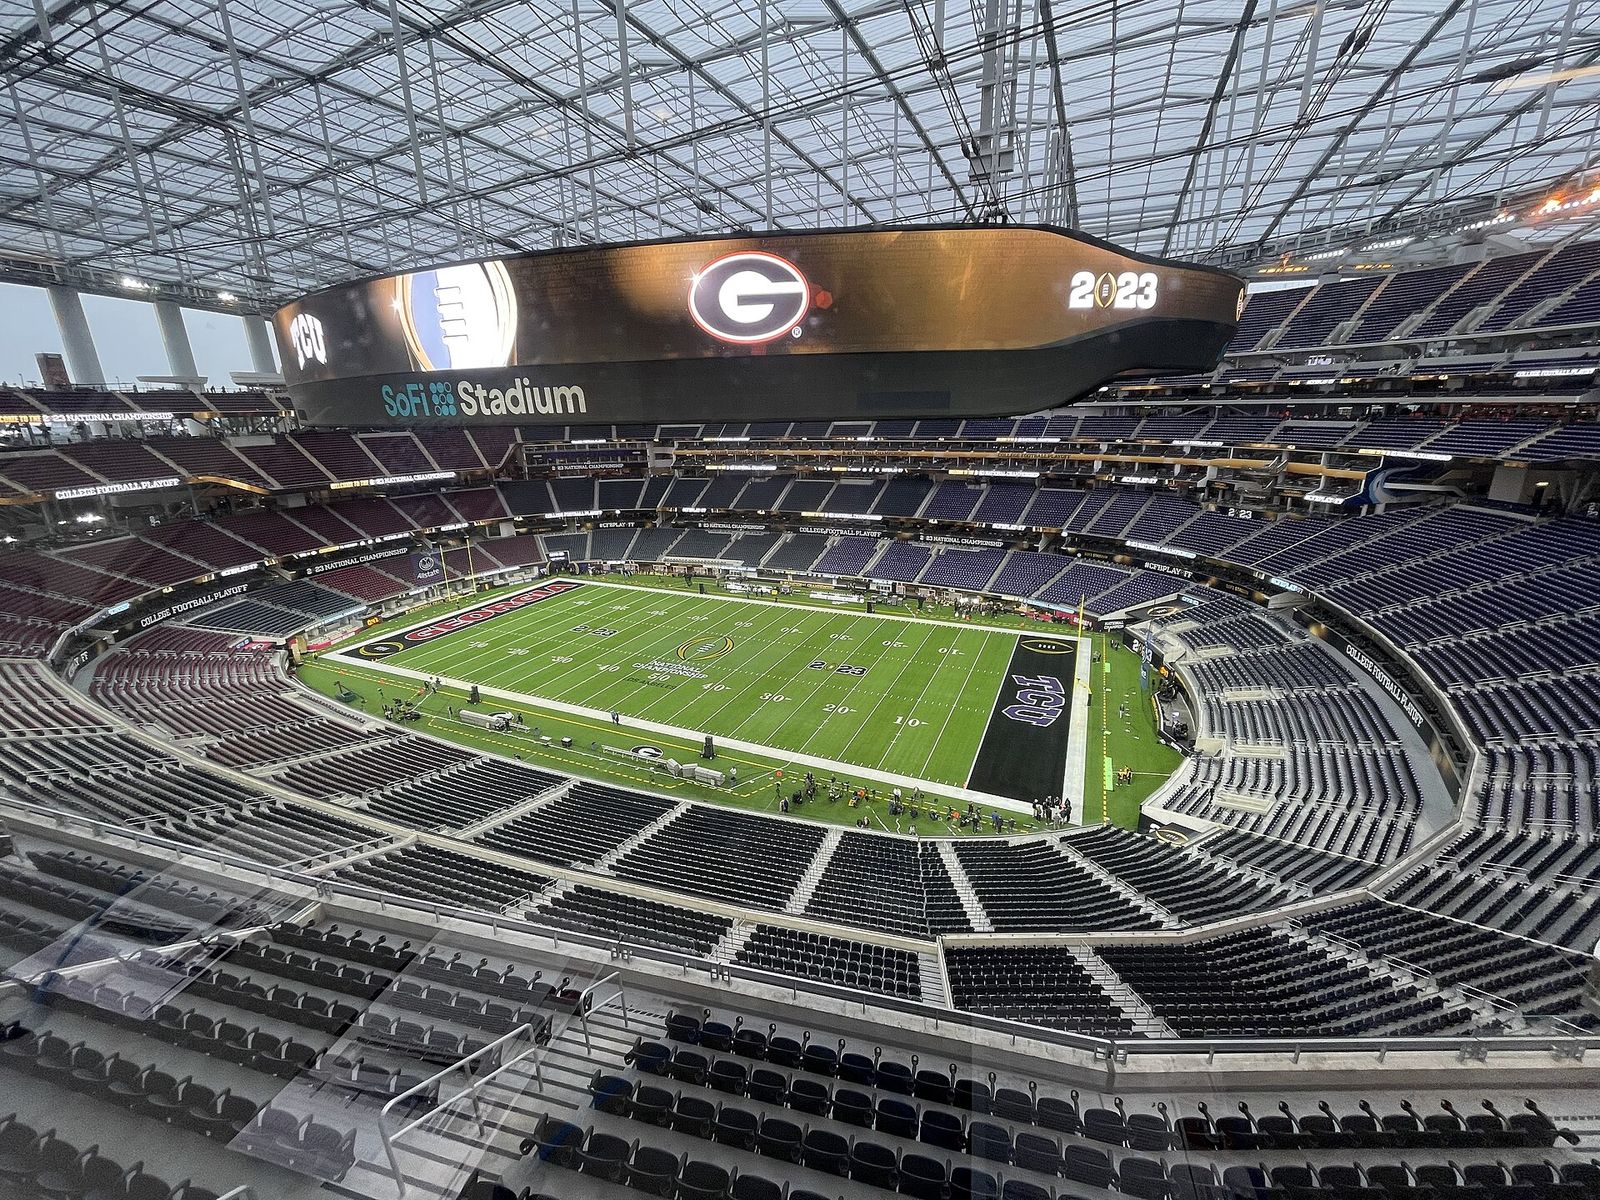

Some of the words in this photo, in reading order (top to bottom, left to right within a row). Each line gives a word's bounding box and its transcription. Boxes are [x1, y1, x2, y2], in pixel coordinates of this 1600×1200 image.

[289, 313, 328, 371] TCU
[381, 383, 430, 418] SoFi
[456, 377, 587, 418] Stadium
[56, 488, 96, 500] COLLEGE
[96, 484, 142, 495] FOOTBALL
[141, 478, 180, 489] PLAYOFF
[825, 528, 855, 536] FOOTBALL
[855, 530, 882, 538] PLAYOFF
[933, 536, 961, 544] NATIONAL
[961, 538, 1004, 547] CHAMPIONSHIP
[324, 557, 359, 572] NATIONAL
[359, 547, 408, 563] CHAMPIONSHIP
[1145, 562, 1193, 579] #CFBPLAYFF
[416, 568, 440, 580] Allstate
[140, 608, 172, 628] COLLEGE
[171, 594, 214, 615] FOOTBALL
[213, 584, 249, 600] PLAYOFF
[404, 582, 576, 641] GEORGIA
[632, 662, 709, 680] CHAMPIONSHIP
[651, 659, 701, 674] NATIONAL
[1346, 644, 1374, 673] COLLEGE
[1372, 665, 1401, 701] FOOTBALL
[1400, 693, 1424, 728] PLAYOFF
[647, 673, 671, 682] 50
[702, 682, 725, 692] 40
[759, 692, 785, 703] 30
[822, 703, 849, 715] 20
[893, 715, 921, 728] 10
[1002, 674, 1066, 728] TCU
